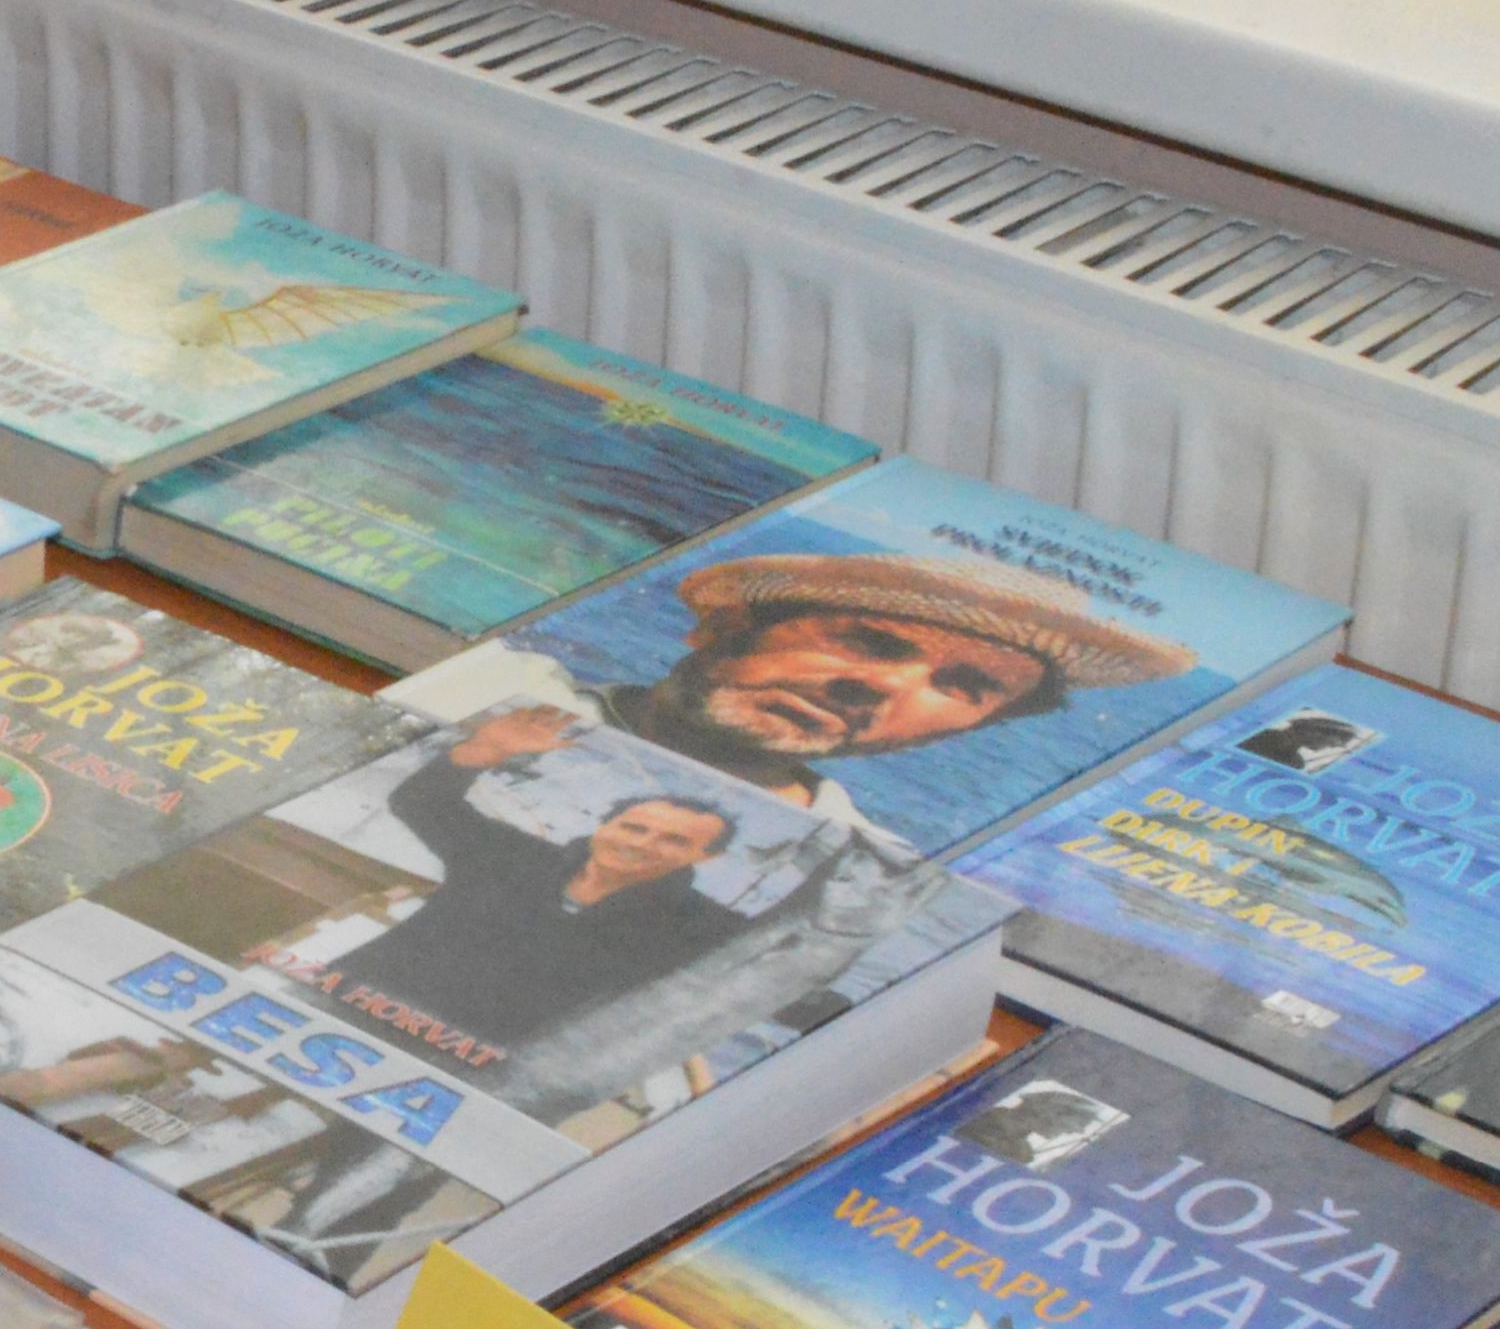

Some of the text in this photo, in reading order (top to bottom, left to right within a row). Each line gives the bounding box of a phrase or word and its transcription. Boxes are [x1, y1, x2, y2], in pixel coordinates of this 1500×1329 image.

[252, 213, 438, 287] JOŽA HORVAT
[83, 665, 302, 761] JOŽA
[46, 739, 186, 817] LISICA
[1141, 786, 1305, 859] DUPIN
[1097, 810, 1218, 869] DIRK
[1058, 834, 1430, 990] LIJENA KOBILA
[106, 949, 468, 1148] BESA
[242, 941, 508, 1072] JOŽA HORVAT
[830, 1187, 1094, 1325] WAITAPU
[1109, 1153, 1406, 1310] JOŽA
